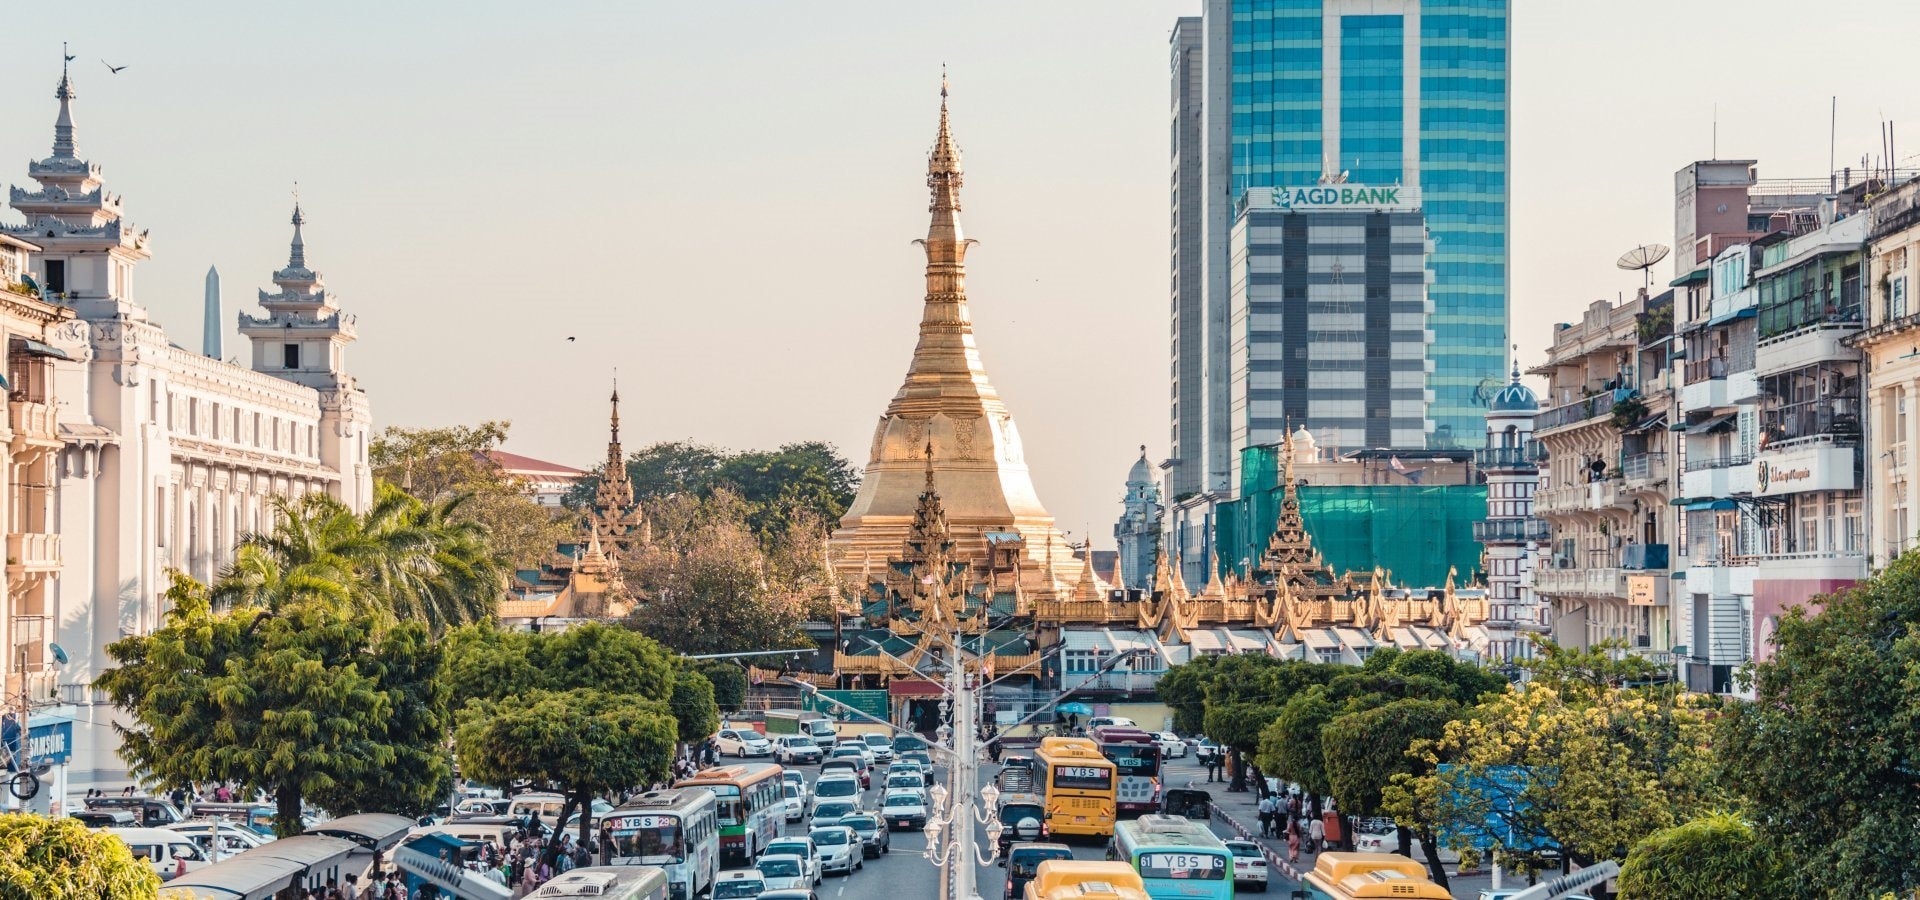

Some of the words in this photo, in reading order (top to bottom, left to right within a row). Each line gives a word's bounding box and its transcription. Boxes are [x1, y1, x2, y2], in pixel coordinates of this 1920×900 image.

[1293, 188, 1338, 205] AGD
[1341, 188, 1400, 205] BANK
[30, 733, 65, 757] SAMSUNG
[1122, 758, 1139, 766] YBS
[1071, 767, 1095, 777] YBS
[624, 818, 652, 828] YBS
[659, 817, 670, 827] 29
[1140, 856, 1151, 867] 61
[1164, 856, 1199, 868] YBS
